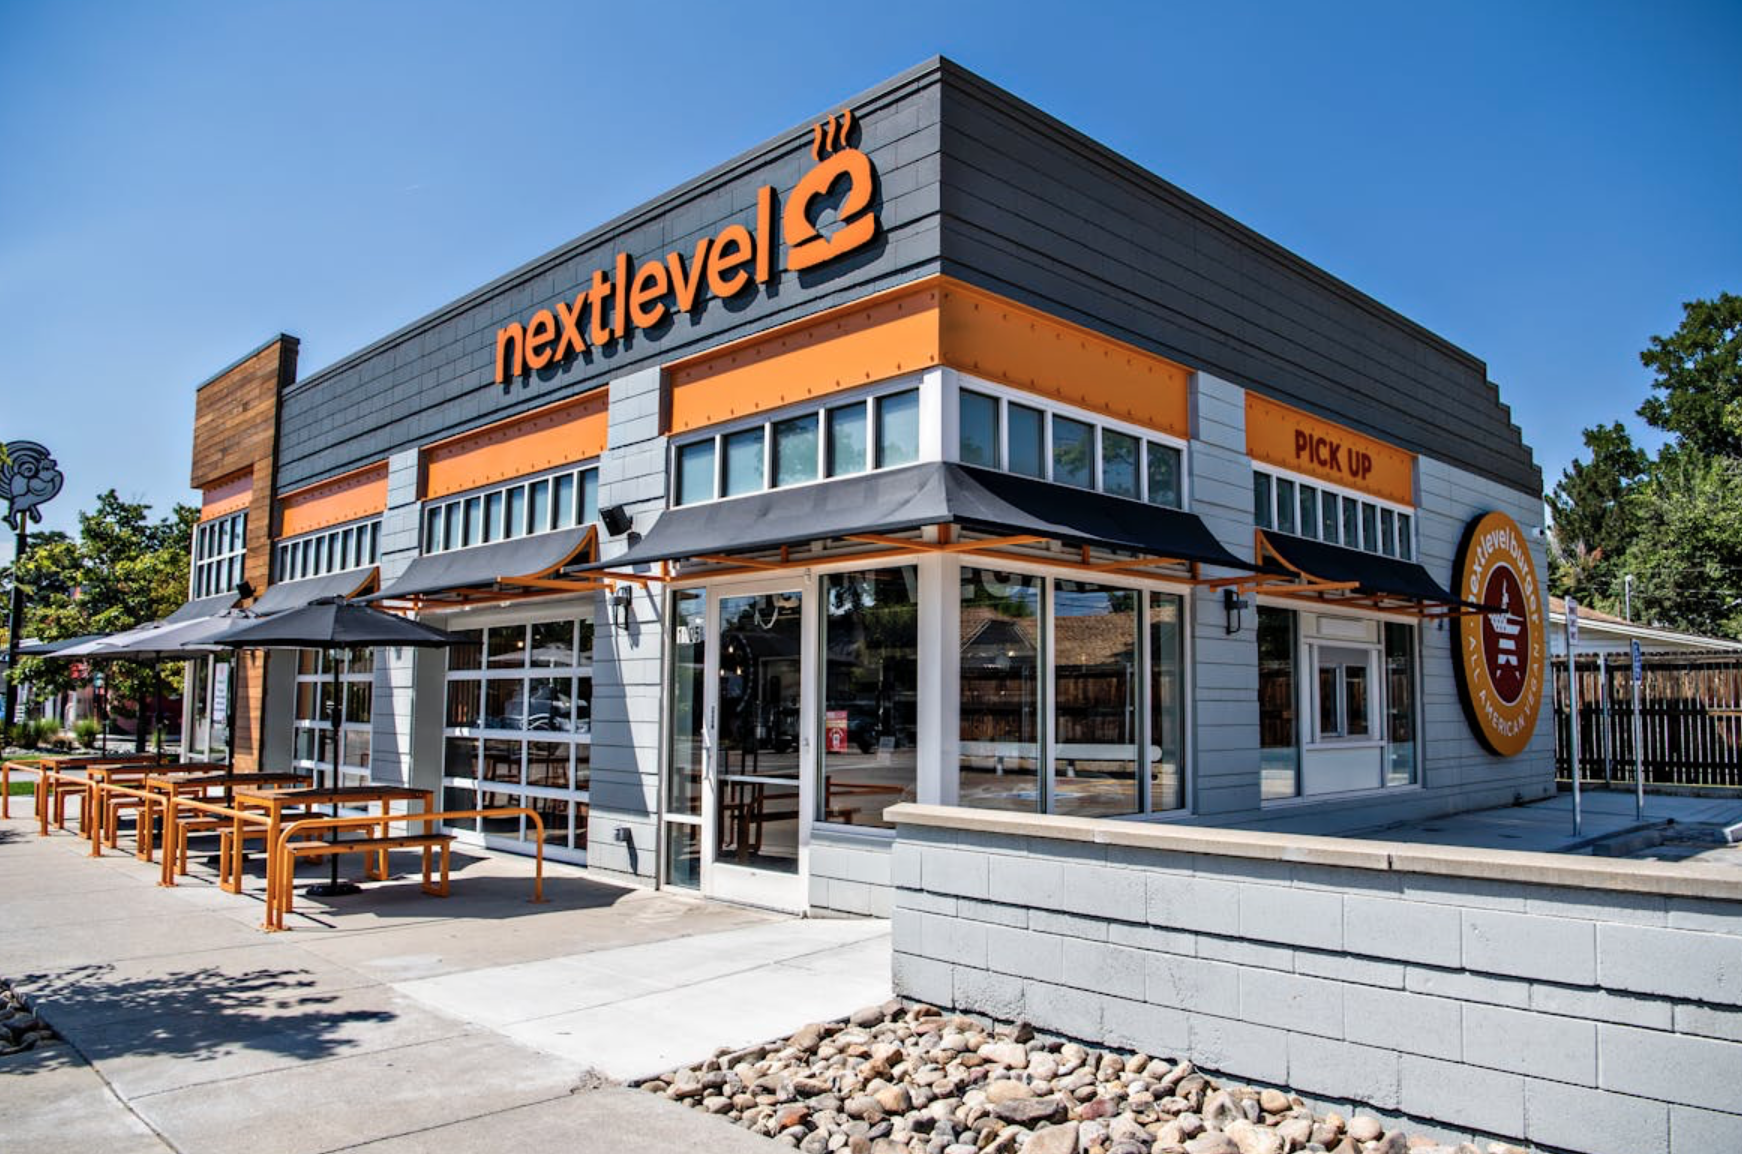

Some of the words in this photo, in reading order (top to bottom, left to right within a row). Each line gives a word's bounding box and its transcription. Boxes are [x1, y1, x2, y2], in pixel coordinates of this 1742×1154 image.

[494, 185, 775, 384] nextlevel
[1295, 428, 1342, 472] PICK
[1348, 448, 1372, 480] UP
[1469, 636, 1480, 684] ALL
[1479, 689, 1525, 737] AMERICAN
